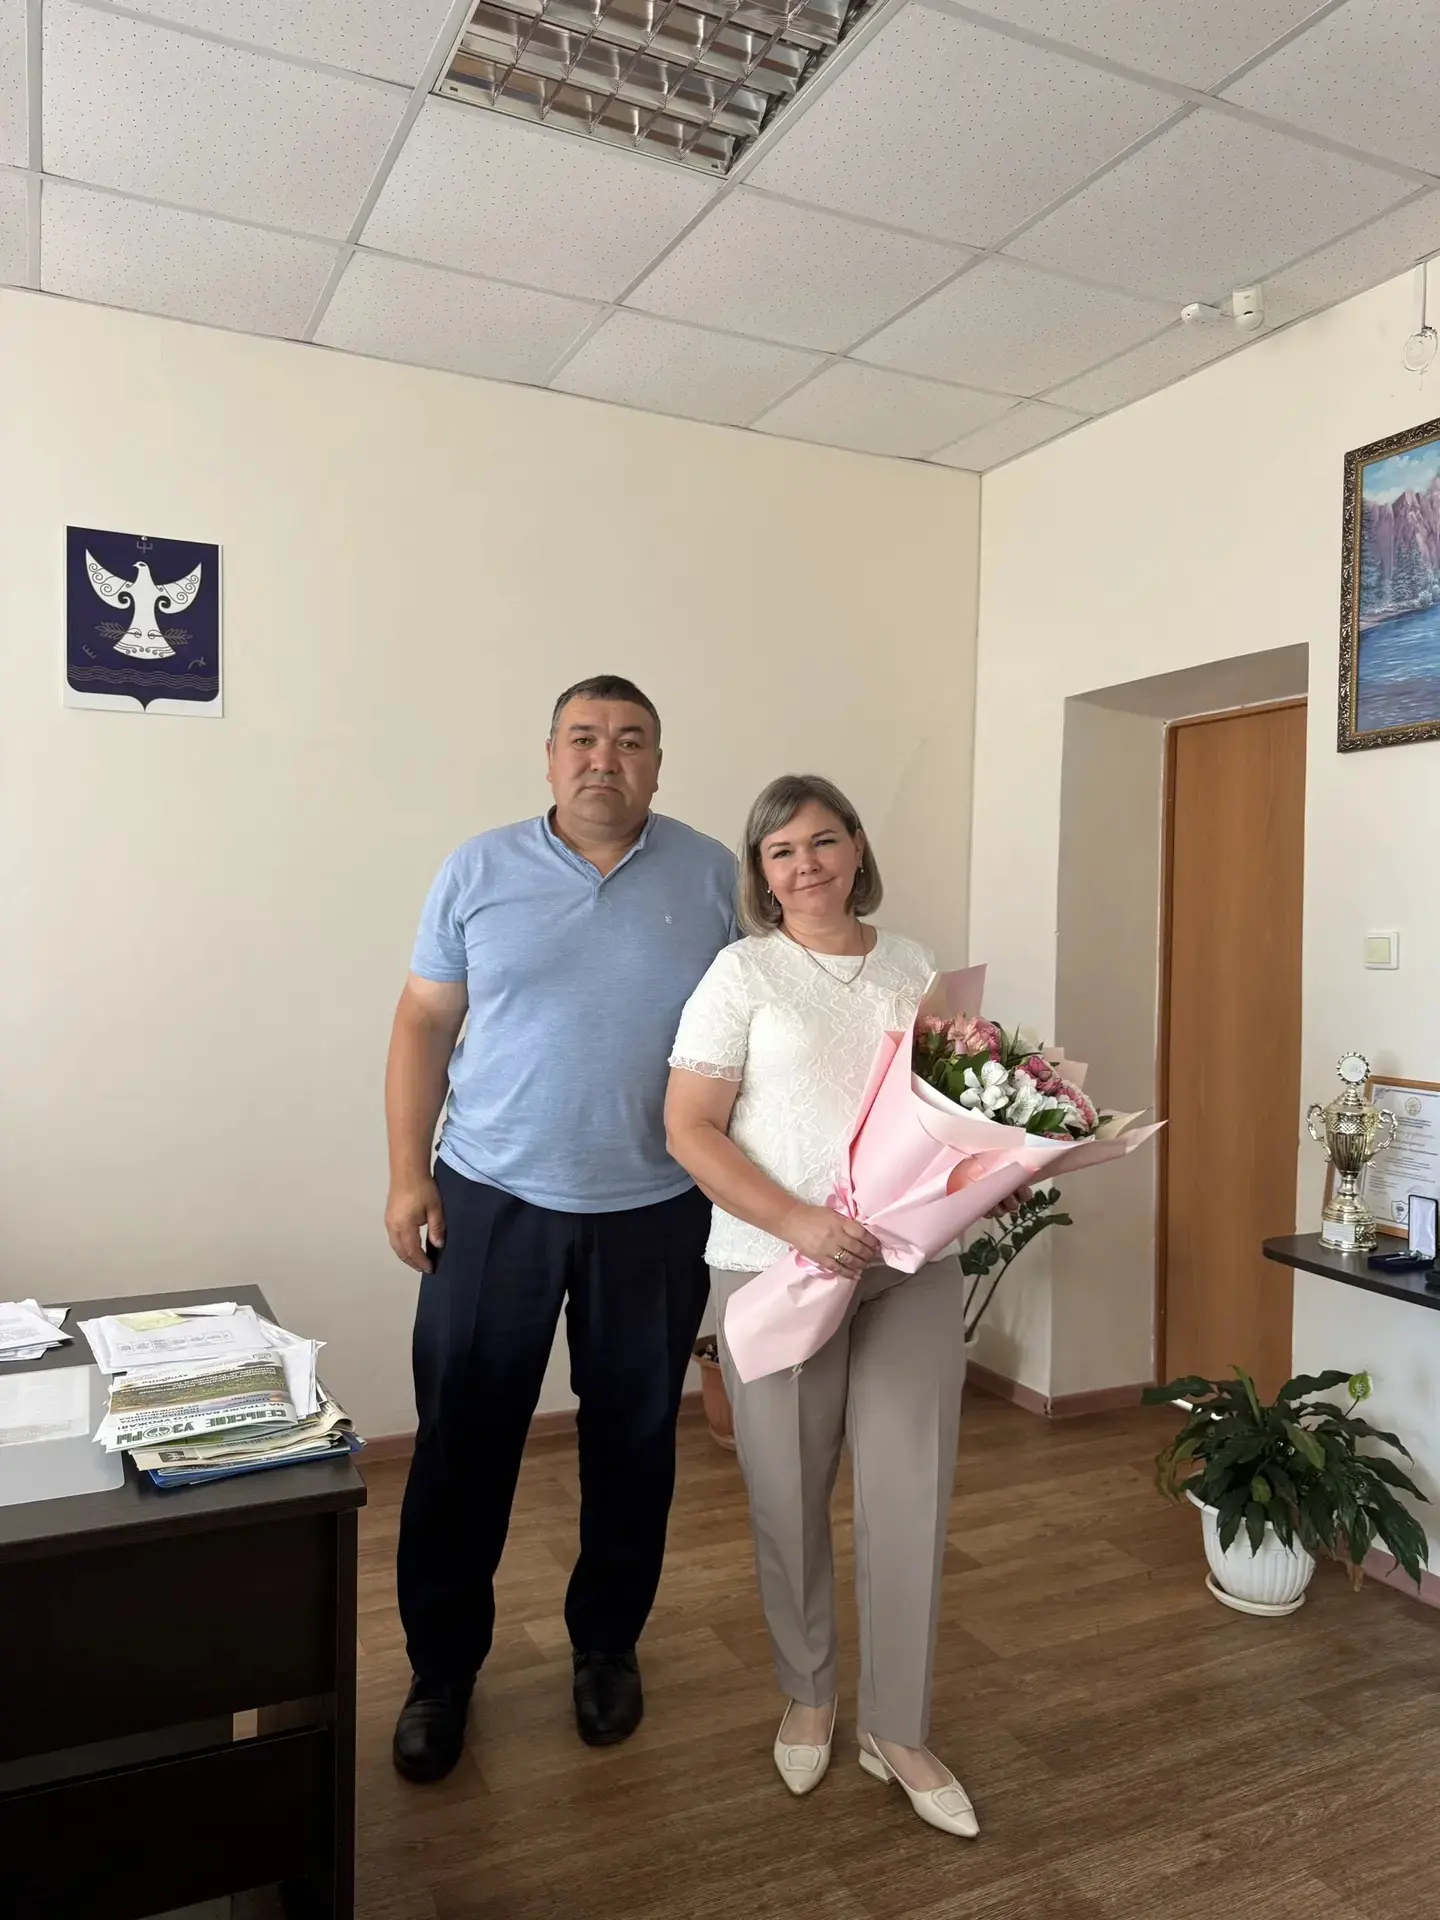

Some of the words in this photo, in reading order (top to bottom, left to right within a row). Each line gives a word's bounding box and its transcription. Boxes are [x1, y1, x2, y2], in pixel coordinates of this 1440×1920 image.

[222, 1403, 266, 1412] СТРАЖЕ
[173, 1411, 220, 1421] ВАШЕГО
[205, 1409, 287, 1428] СЕЛЬСКИЕ
